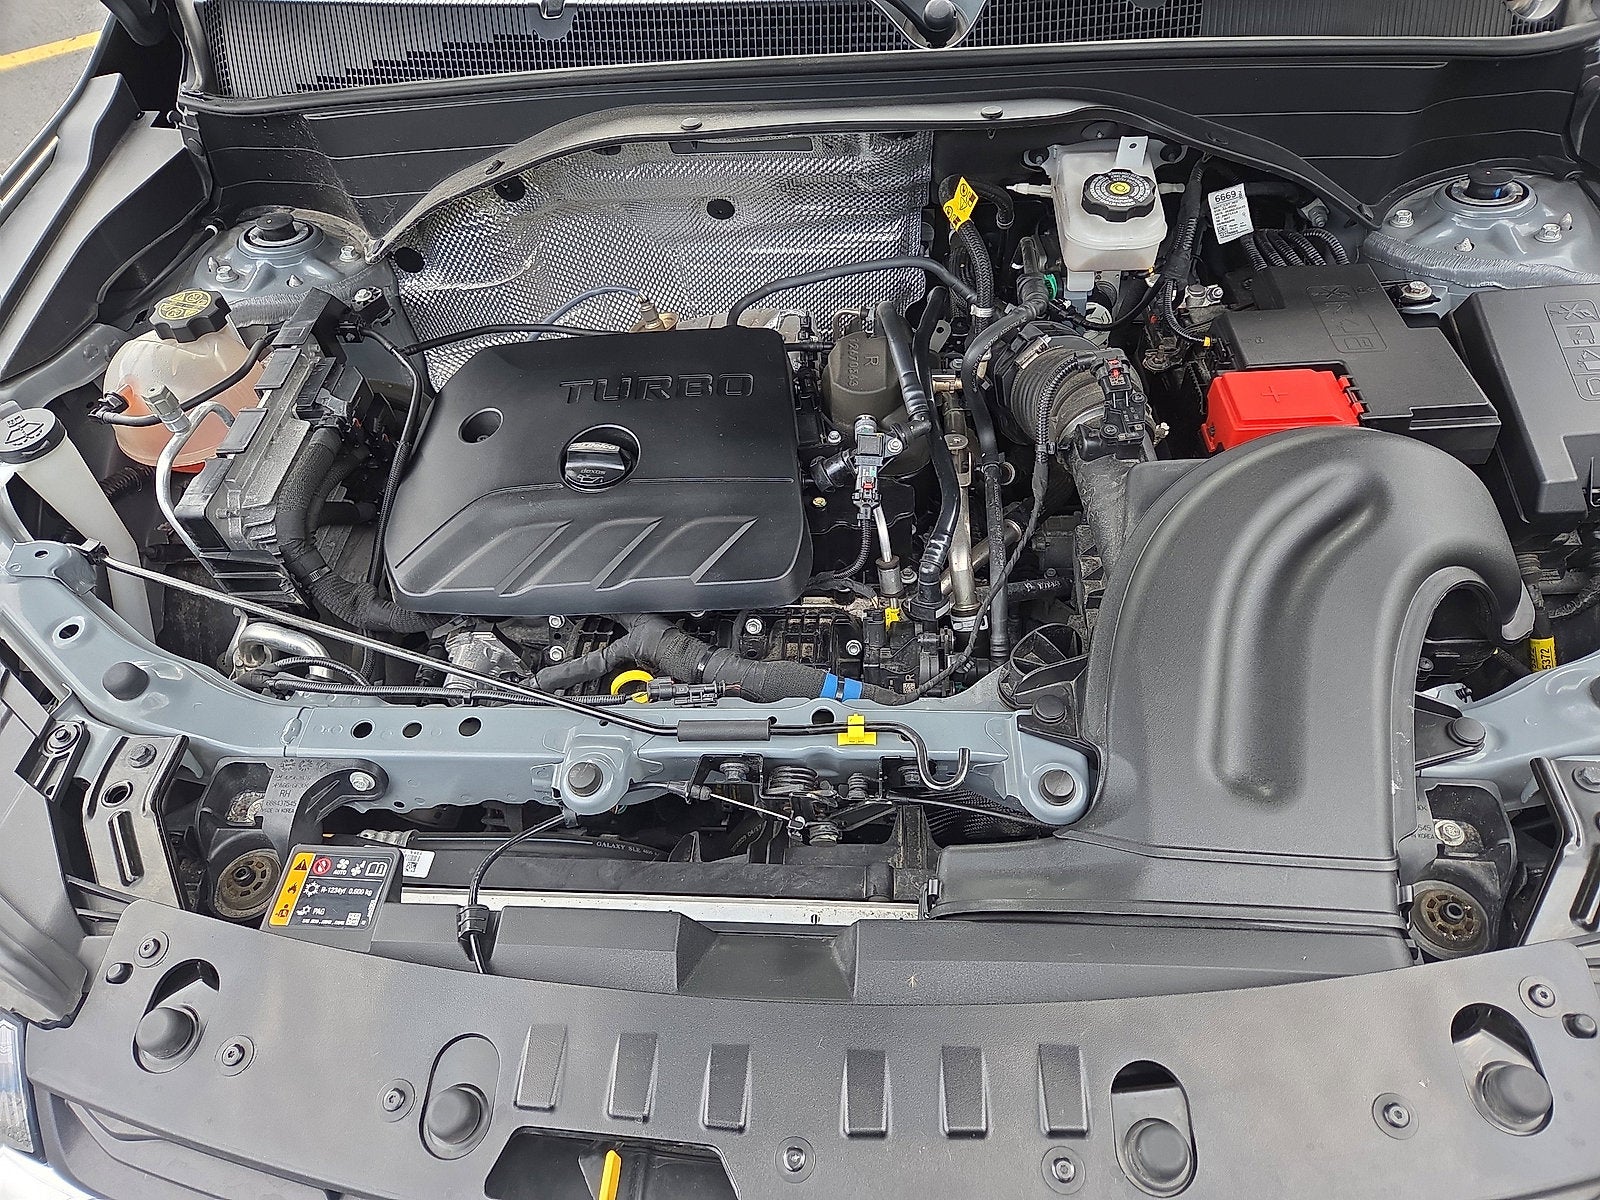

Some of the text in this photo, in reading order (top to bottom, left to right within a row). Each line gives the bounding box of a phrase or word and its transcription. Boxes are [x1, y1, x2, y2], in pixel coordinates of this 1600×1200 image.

[1214, 190, 1237, 203] 6669
[864, 356, 879, 366] R
[559, 374, 755, 404] TURBO
[1540, 648, 1552, 670] 5372
[279, 789, 291, 798] RH
[596, 841, 625, 850] GALAXY
[320, 886, 347, 896] R-1234yf
[365, 888, 373, 897] kg
[312, 907, 326, 916] PAG
